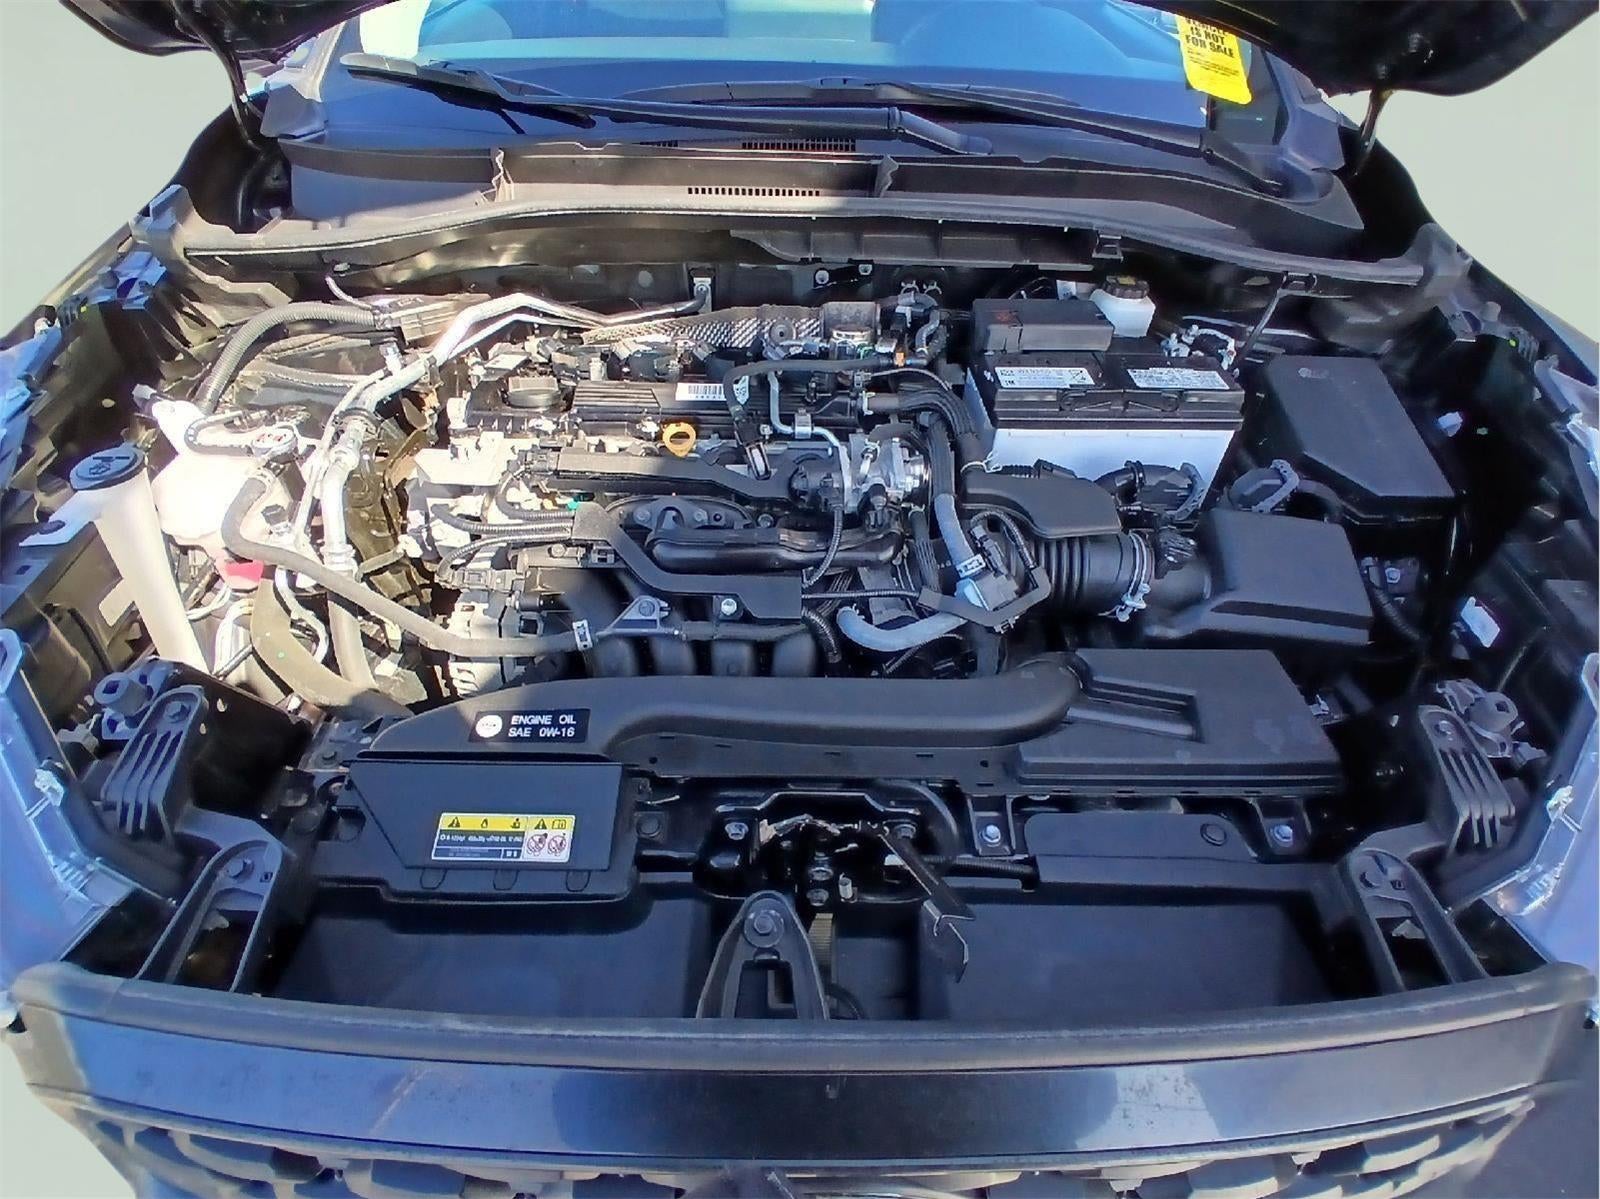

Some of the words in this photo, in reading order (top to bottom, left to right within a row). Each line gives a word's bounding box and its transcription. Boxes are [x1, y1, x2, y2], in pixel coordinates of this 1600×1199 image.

[1191, 26, 1202, 38] IS
[1204, 30, 1224, 45] NOT
[1185, 35, 1206, 48] FOR
[1209, 42, 1235, 58] SALE
[511, 715, 552, 725] ENGINE
[559, 714, 576, 724] OIL
[508, 727, 532, 737] SAE
[539, 727, 575, 737] 0W-16
